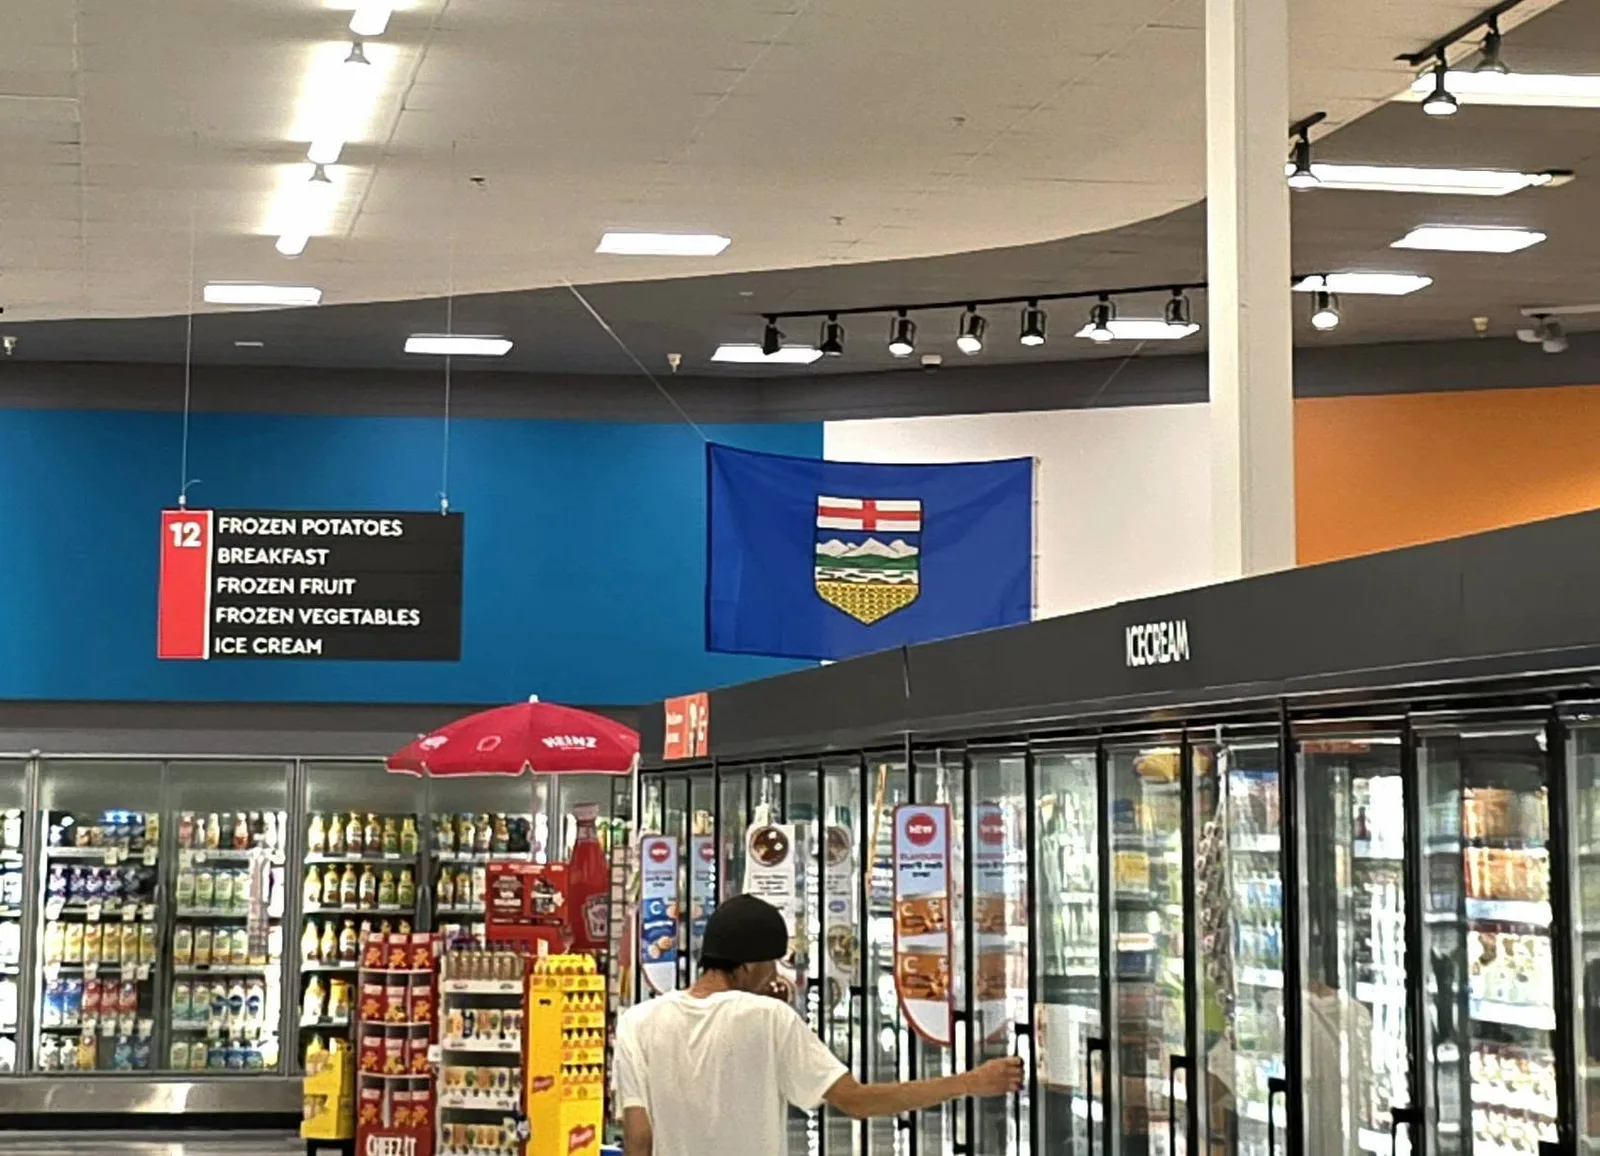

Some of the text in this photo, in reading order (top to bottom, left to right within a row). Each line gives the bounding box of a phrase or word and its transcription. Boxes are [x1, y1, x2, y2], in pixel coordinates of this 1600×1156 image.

[169, 522, 201, 547] 12
[219, 518, 402, 536] FROZEN POTATOES
[218, 548, 329, 565] BREAKFAST
[217, 577, 356, 594] FROZEN FRUIT
[216, 607, 419, 625] FROZEN VEGETABLES
[215, 637, 321, 654] ICE CREAM
[541, 735, 598, 748] HEINZ
